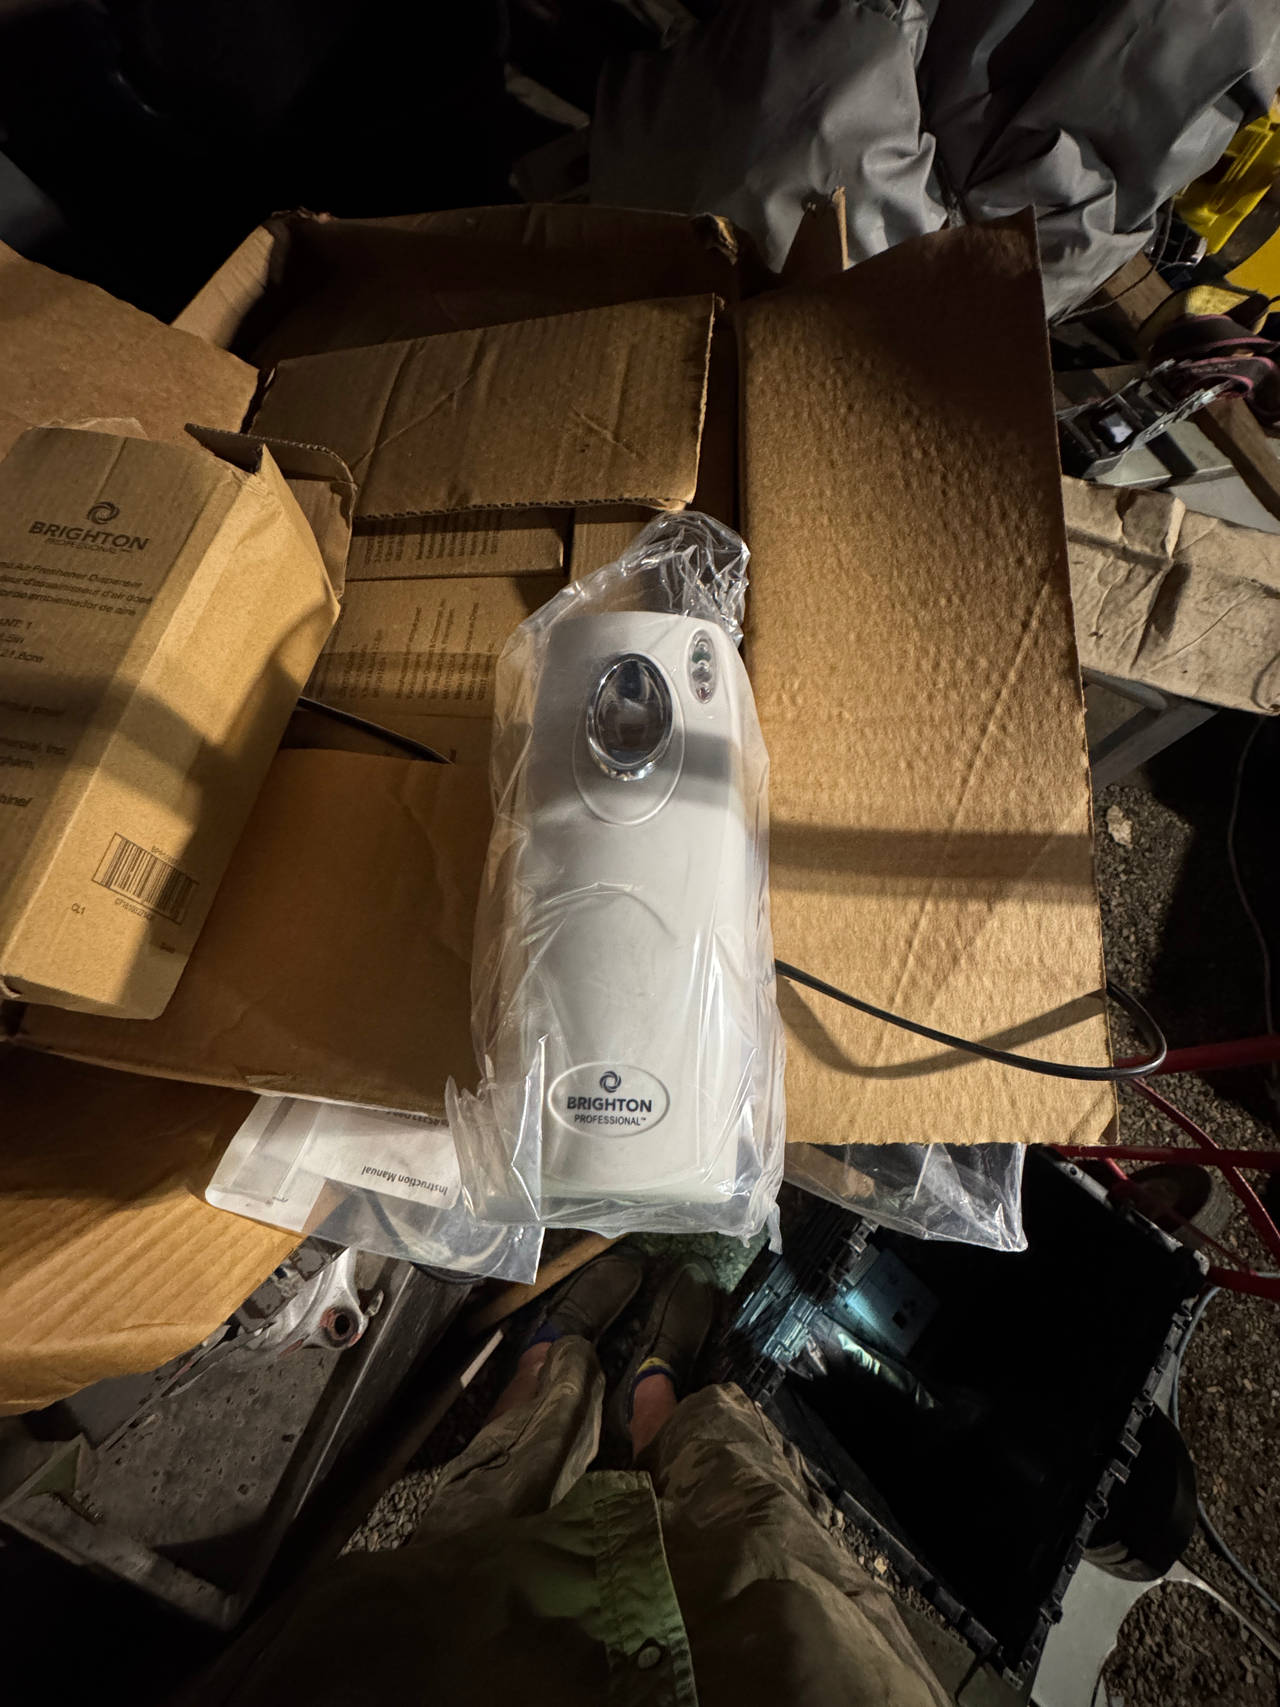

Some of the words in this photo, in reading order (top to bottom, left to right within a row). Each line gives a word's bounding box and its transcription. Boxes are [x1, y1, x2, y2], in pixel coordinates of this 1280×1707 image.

[28, 520, 150, 551] BRIGHTON
[567, 1096, 653, 1113] BRIGHTON
[361, 1165, 398, 1183] Manual
[398, 1175, 449, 1197] Instruction
